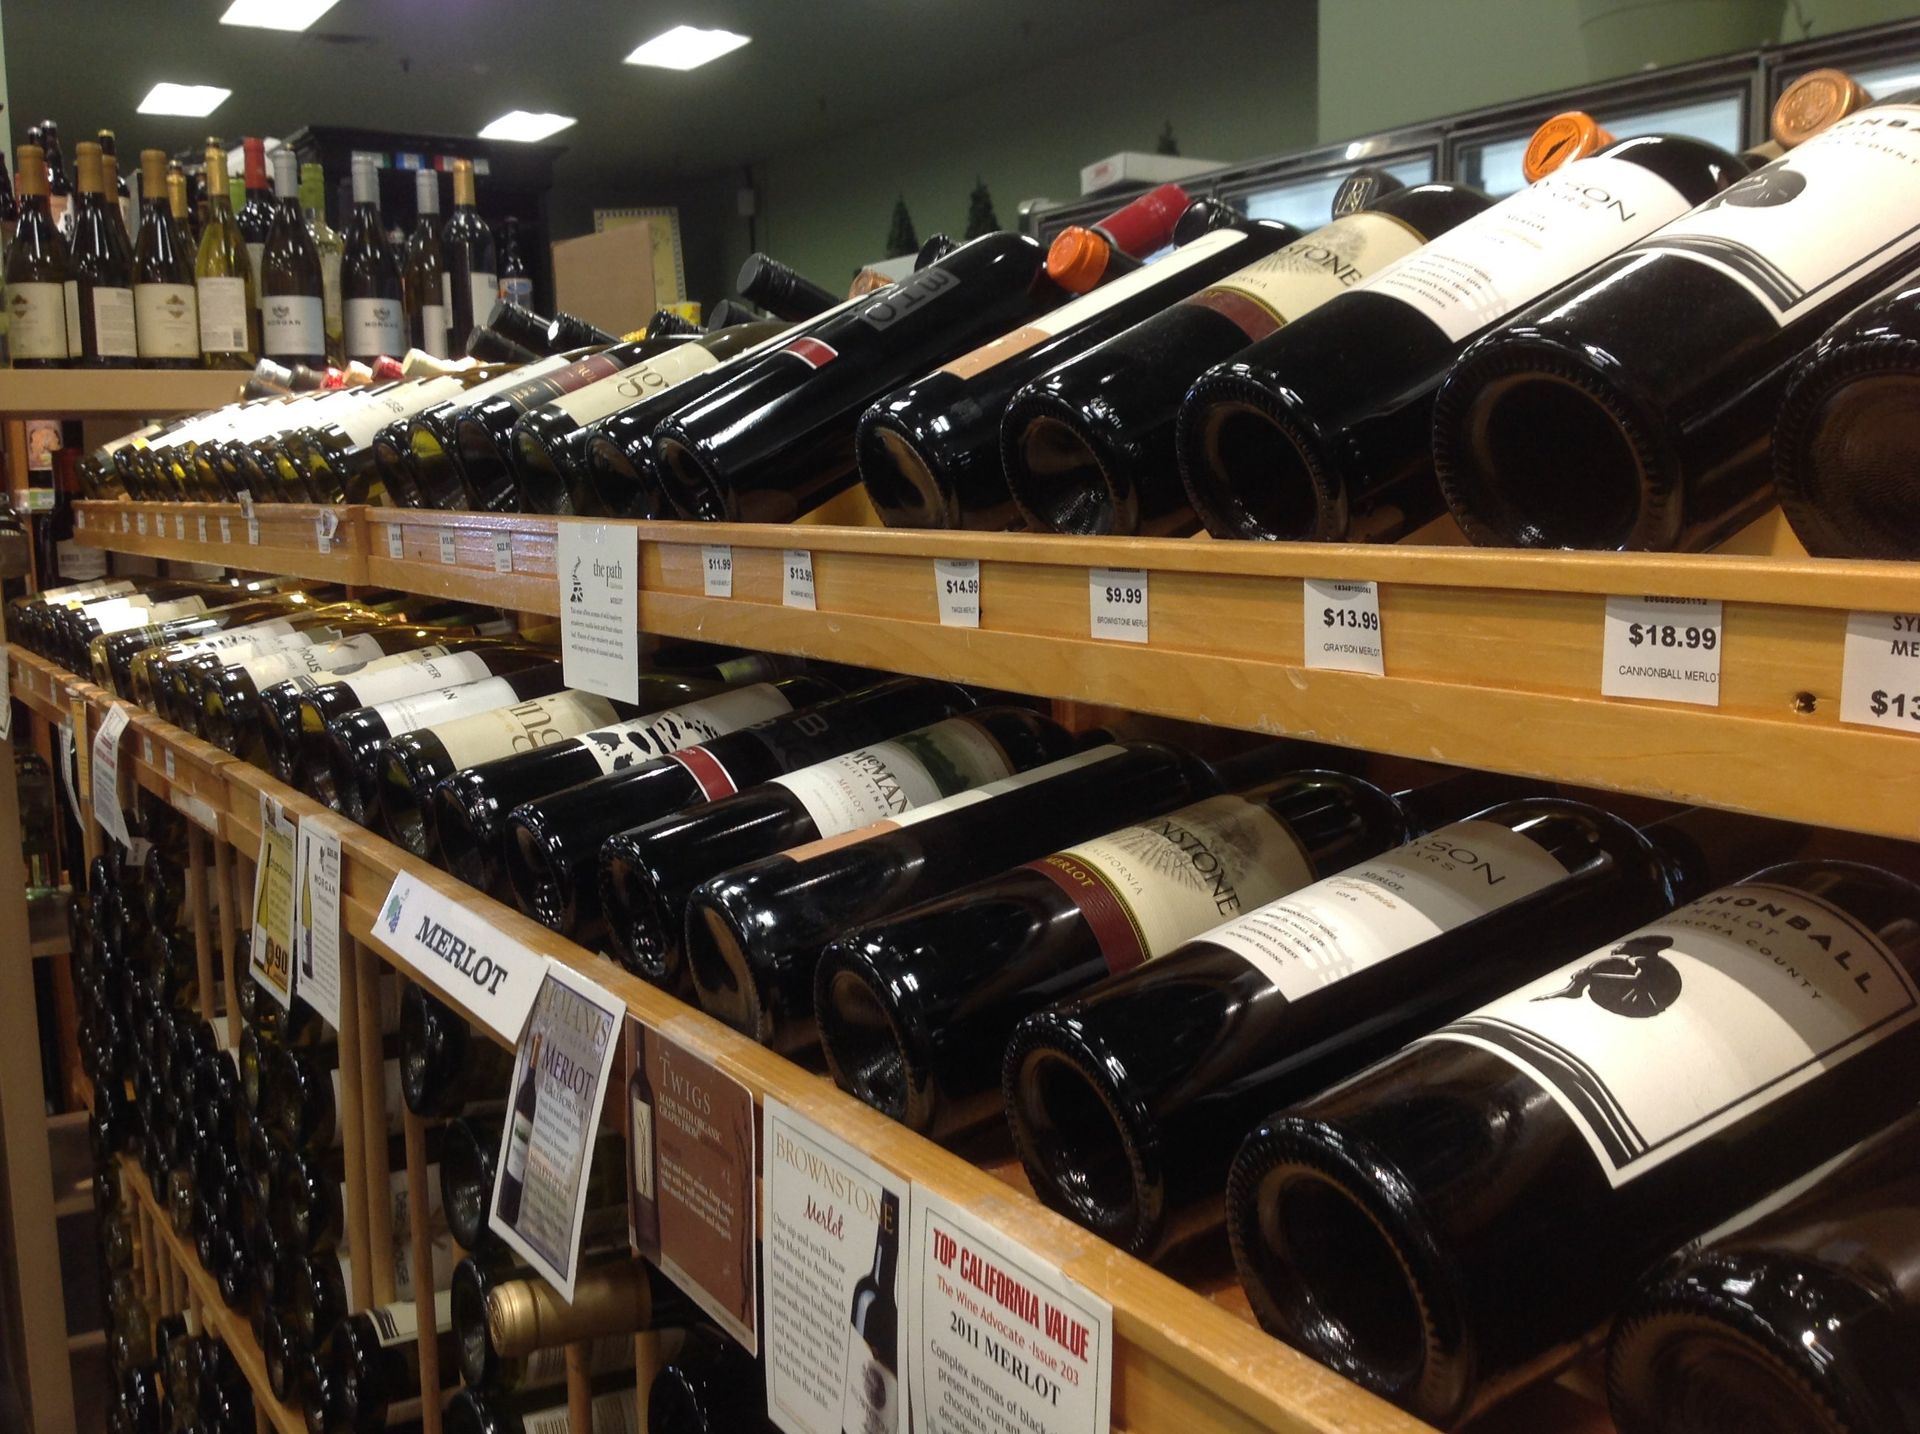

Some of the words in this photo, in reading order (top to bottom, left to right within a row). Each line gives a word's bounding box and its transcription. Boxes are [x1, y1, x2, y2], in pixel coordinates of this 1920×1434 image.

[593, 558, 604, 579] the
[606, 560, 623, 588] path
[709, 558, 731, 571] $11.99
[946, 579, 978, 595] $14.99
[1106, 586, 1142, 604] $9.99
[1097, 616, 1130, 625] BROWNSTONE
[1323, 607, 1379, 631] $13.99
[1323, 642, 1358, 654] GRAYSON
[1628, 623, 1717, 650] $18.99
[1618, 665, 1682, 680] CANNONBALL
[1684, 670, 1719, 683] MERLO
[314, 873, 336, 897] MORGAN
[1046, 854, 1095, 888] MERLOT
[1084, 845, 1144, 896] CALIFORNIA
[1361, 871, 1405, 892] MERLOT
[1693, 909, 1780, 937] MERLOT
[415, 915, 508, 995] MERLOT
[1293, 936, 1312, 953] FROM
[275, 946, 288, 976] 90
[1745, 938, 1822, 1000] COUNTY
[541, 1041, 594, 1101] MERLOT
[659, 1056, 712, 1116] TWIGS
[659, 1090, 676, 1112] MADE
[677, 1101, 693, 1124] WITH
[693, 1112, 721, 1143] ORGANIC
[681, 1118, 698, 1139] FROM
[776, 1132, 895, 1236] BROWNSTONE
[803, 1194, 845, 1242] Merlot
[773, 1210, 785, 1230] One
[787, 1222, 796, 1241] sip
[797, 1227, 808, 1247] and
[810, 1236, 826, 1262] you'll
[828, 1249, 844, 1275] know
[773, 1228, 784, 1251] why
[786, 1239, 805, 1264] Merlot
[813, 1259, 843, 1293] America's
[773, 1264, 784, 1284] and
[787, 1292, 799, 1315] with
[795, 1263, 803, 1281] red
[821, 1283, 845, 1314] Smooth
[932, 1227, 957, 1269] TOP
[960, 1247, 1040, 1329] CALIFORNIA
[1044, 1302, 1090, 1363] VALUE
[774, 1317, 784, 1337] red
[785, 1330, 799, 1350] wine
[790, 1313, 801, 1334] and
[825, 1341, 839, 1365] This
[937, 1274, 953, 1298] The
[956, 1287, 979, 1316] Wine
[980, 1308, 1026, 1347] Advocate
[1060, 1359, 1080, 1386] 203
[783, 1342, 801, 1369] before
[950, 1310, 979, 1350] 2011
[985, 1335, 1062, 1407] MERLOT
[802, 1375, 811, 1396] the
[930, 1338, 969, 1380] Complex
[971, 1372, 1005, 1407] aromas
[1007, 1400, 1018, 1416] of
[1020, 1406, 1046, 1434] black
[938, 1366, 983, 1413] preserves,
